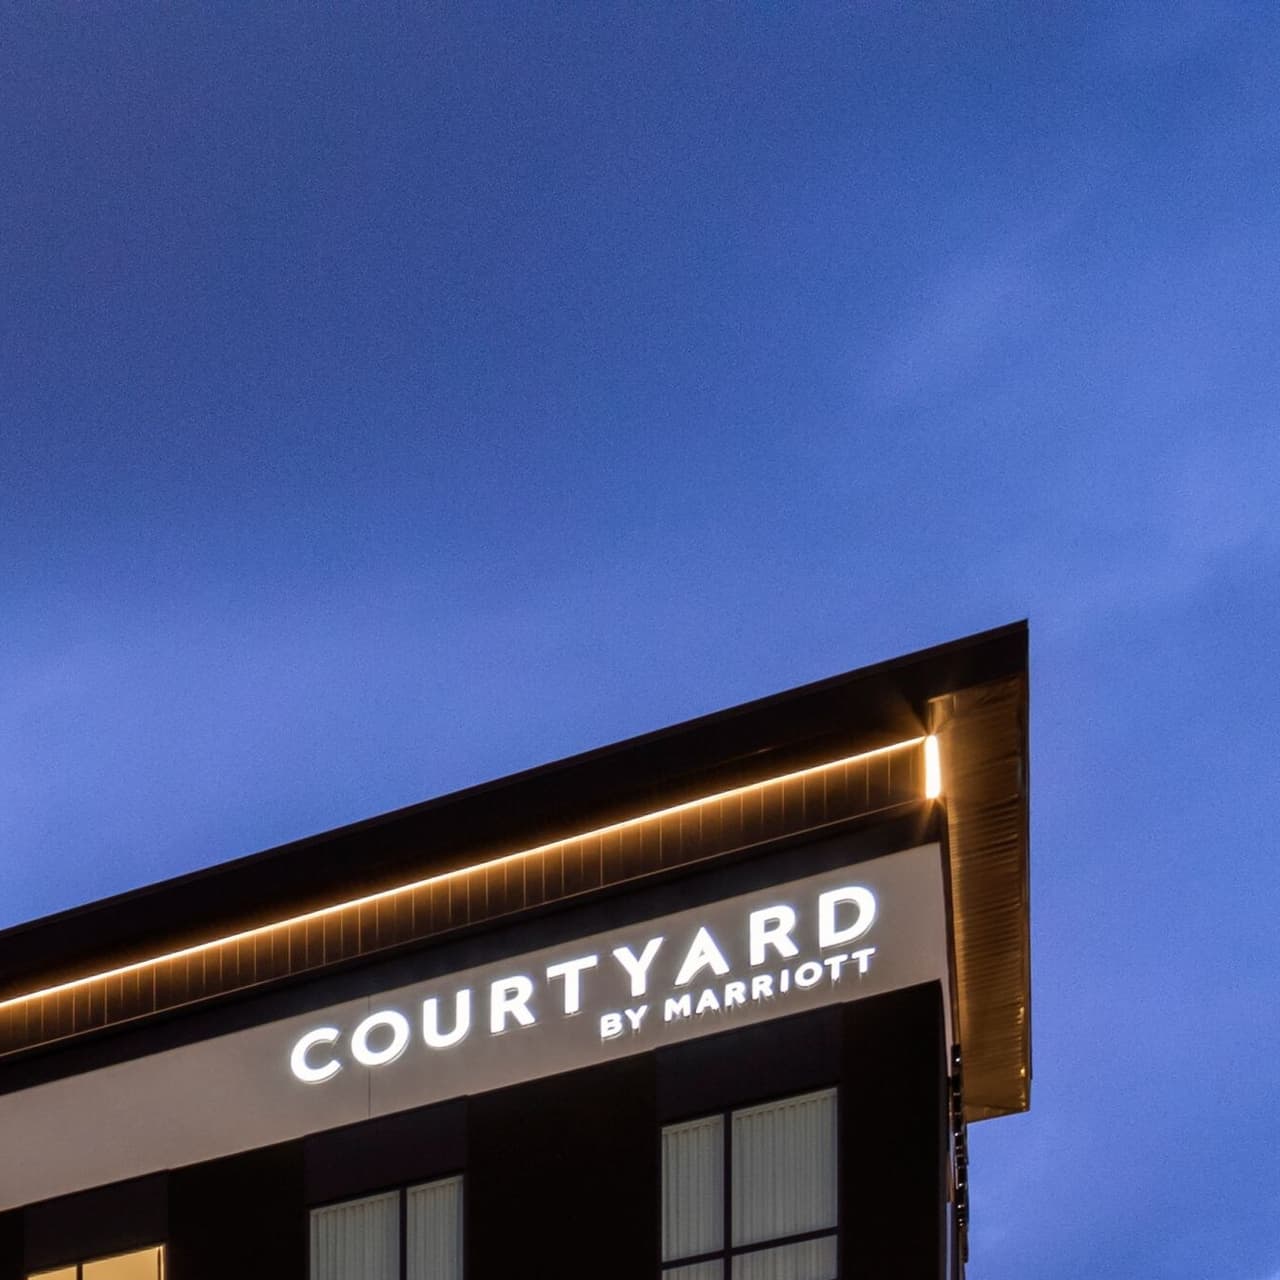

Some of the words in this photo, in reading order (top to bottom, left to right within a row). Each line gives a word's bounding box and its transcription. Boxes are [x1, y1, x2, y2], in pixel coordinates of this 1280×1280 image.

[290, 886, 877, 1083] COURTYARD
[600, 1005, 649, 1039] BY
[664, 947, 876, 1022] MARRIOTT
